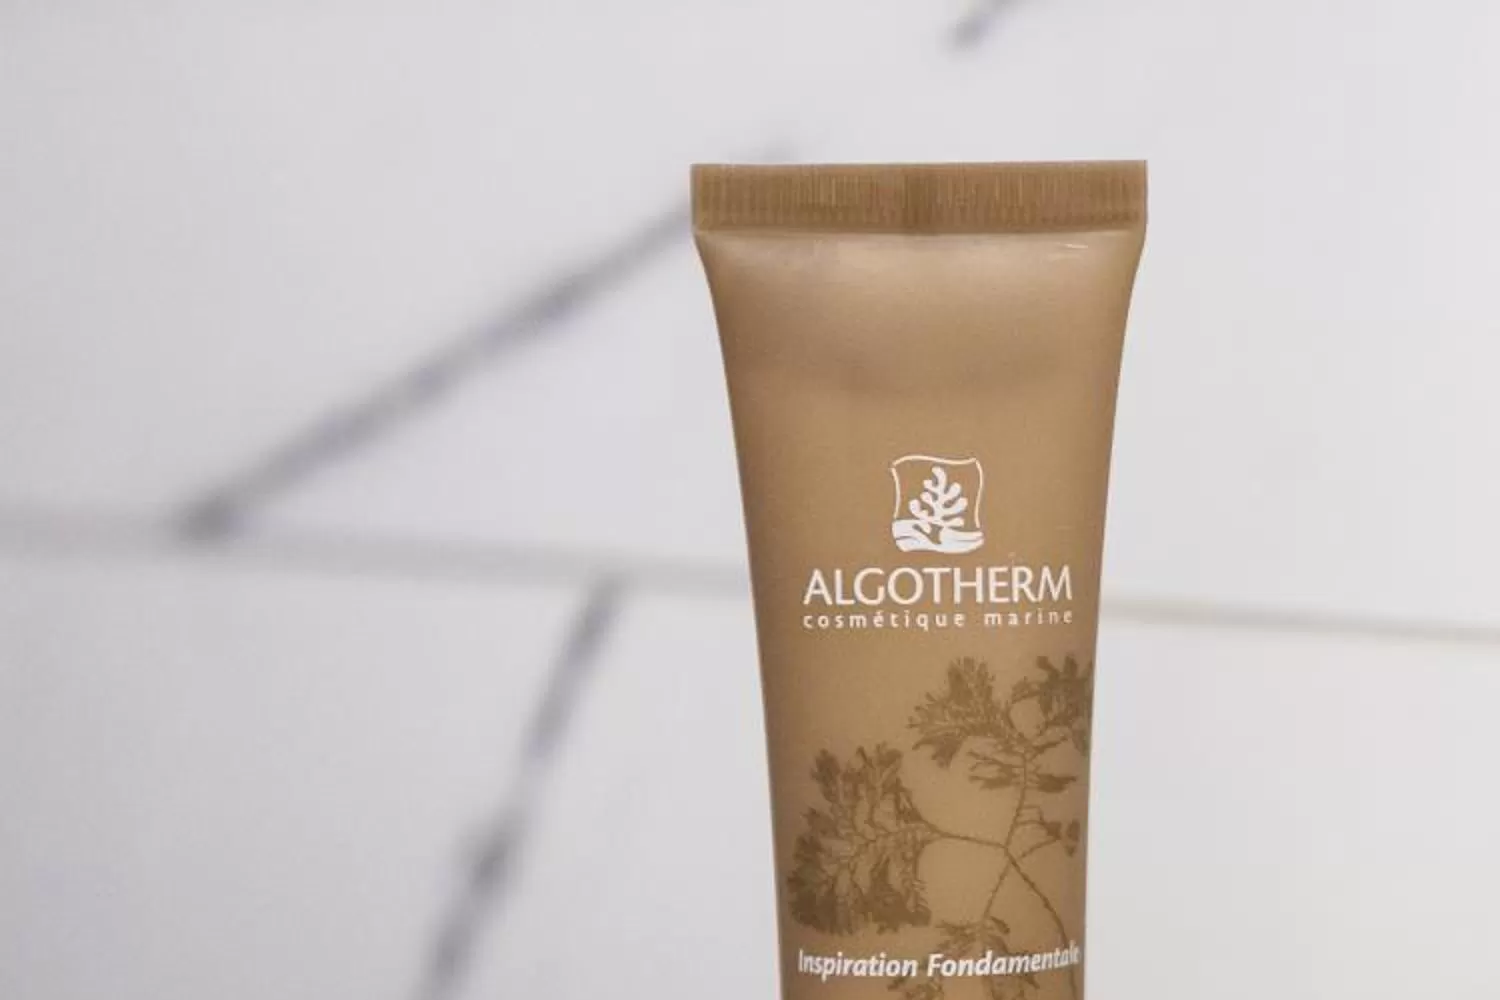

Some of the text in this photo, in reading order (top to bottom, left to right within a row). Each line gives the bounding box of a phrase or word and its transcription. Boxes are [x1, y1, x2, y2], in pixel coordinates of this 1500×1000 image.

[803, 565, 1073, 606] ALGOTHERM
[803, 608, 1073, 632] cosmétique marine
[798, 950, 919, 984] Inspiration
